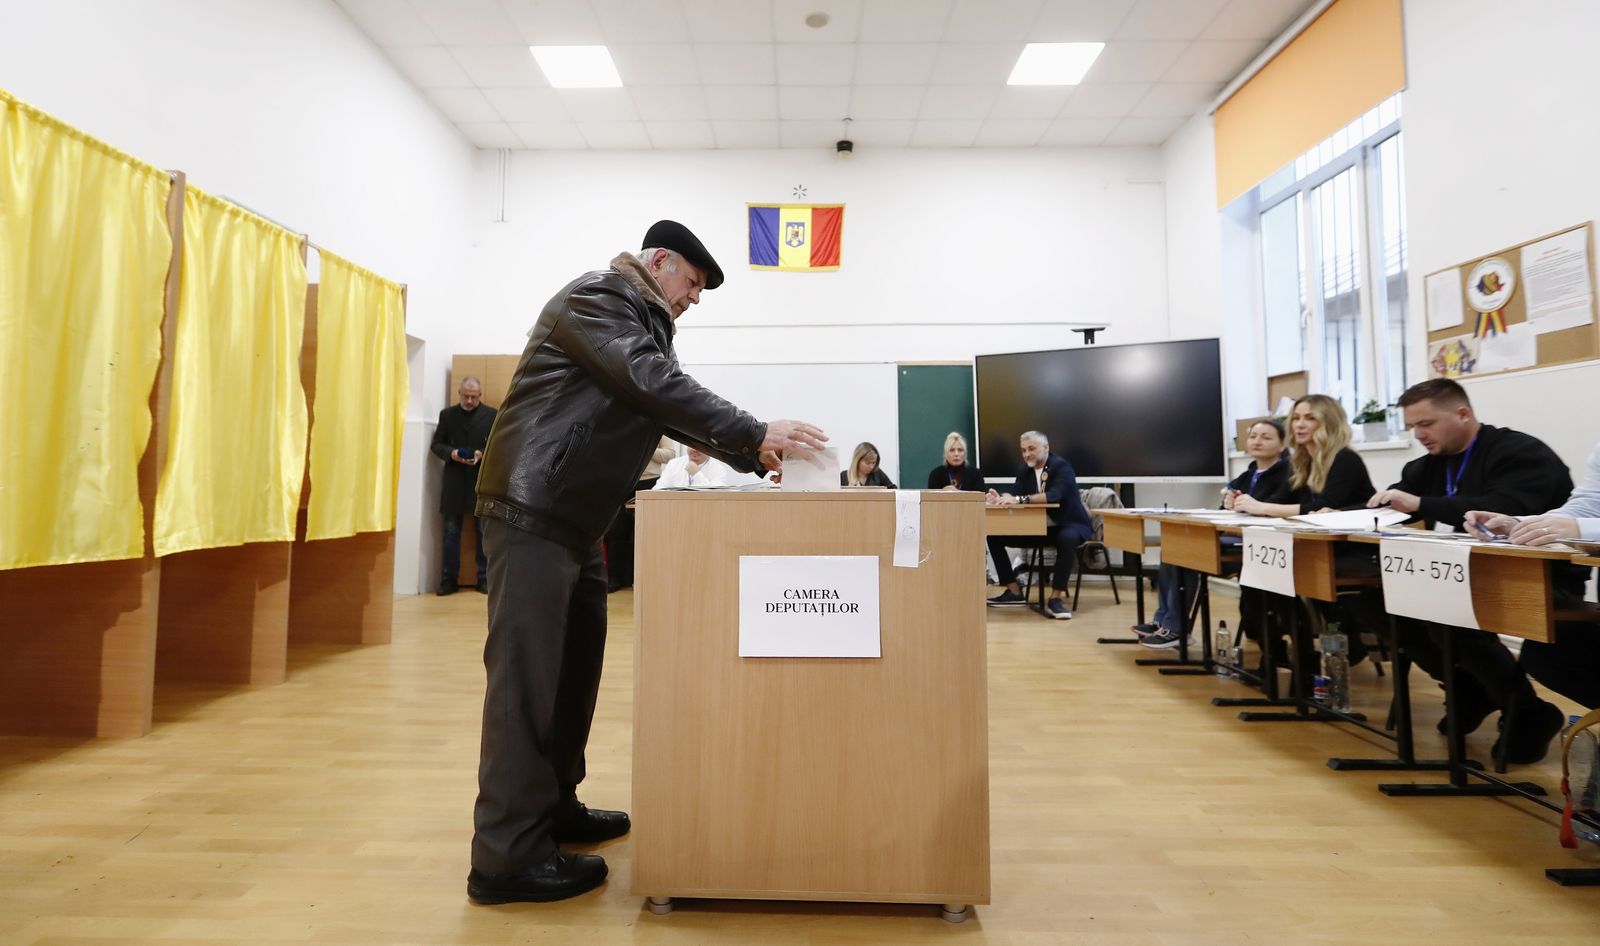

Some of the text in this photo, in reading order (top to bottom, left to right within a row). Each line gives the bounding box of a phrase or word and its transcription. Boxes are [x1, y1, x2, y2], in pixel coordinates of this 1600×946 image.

[1248, 543, 1287, 569] 1-273
[1383, 555, 1415, 575] 274
[1430, 561, 1465, 583] 573
[783, 588, 840, 600] CAMERA
[765, 602, 859, 616] DEPUTAȚILOR
